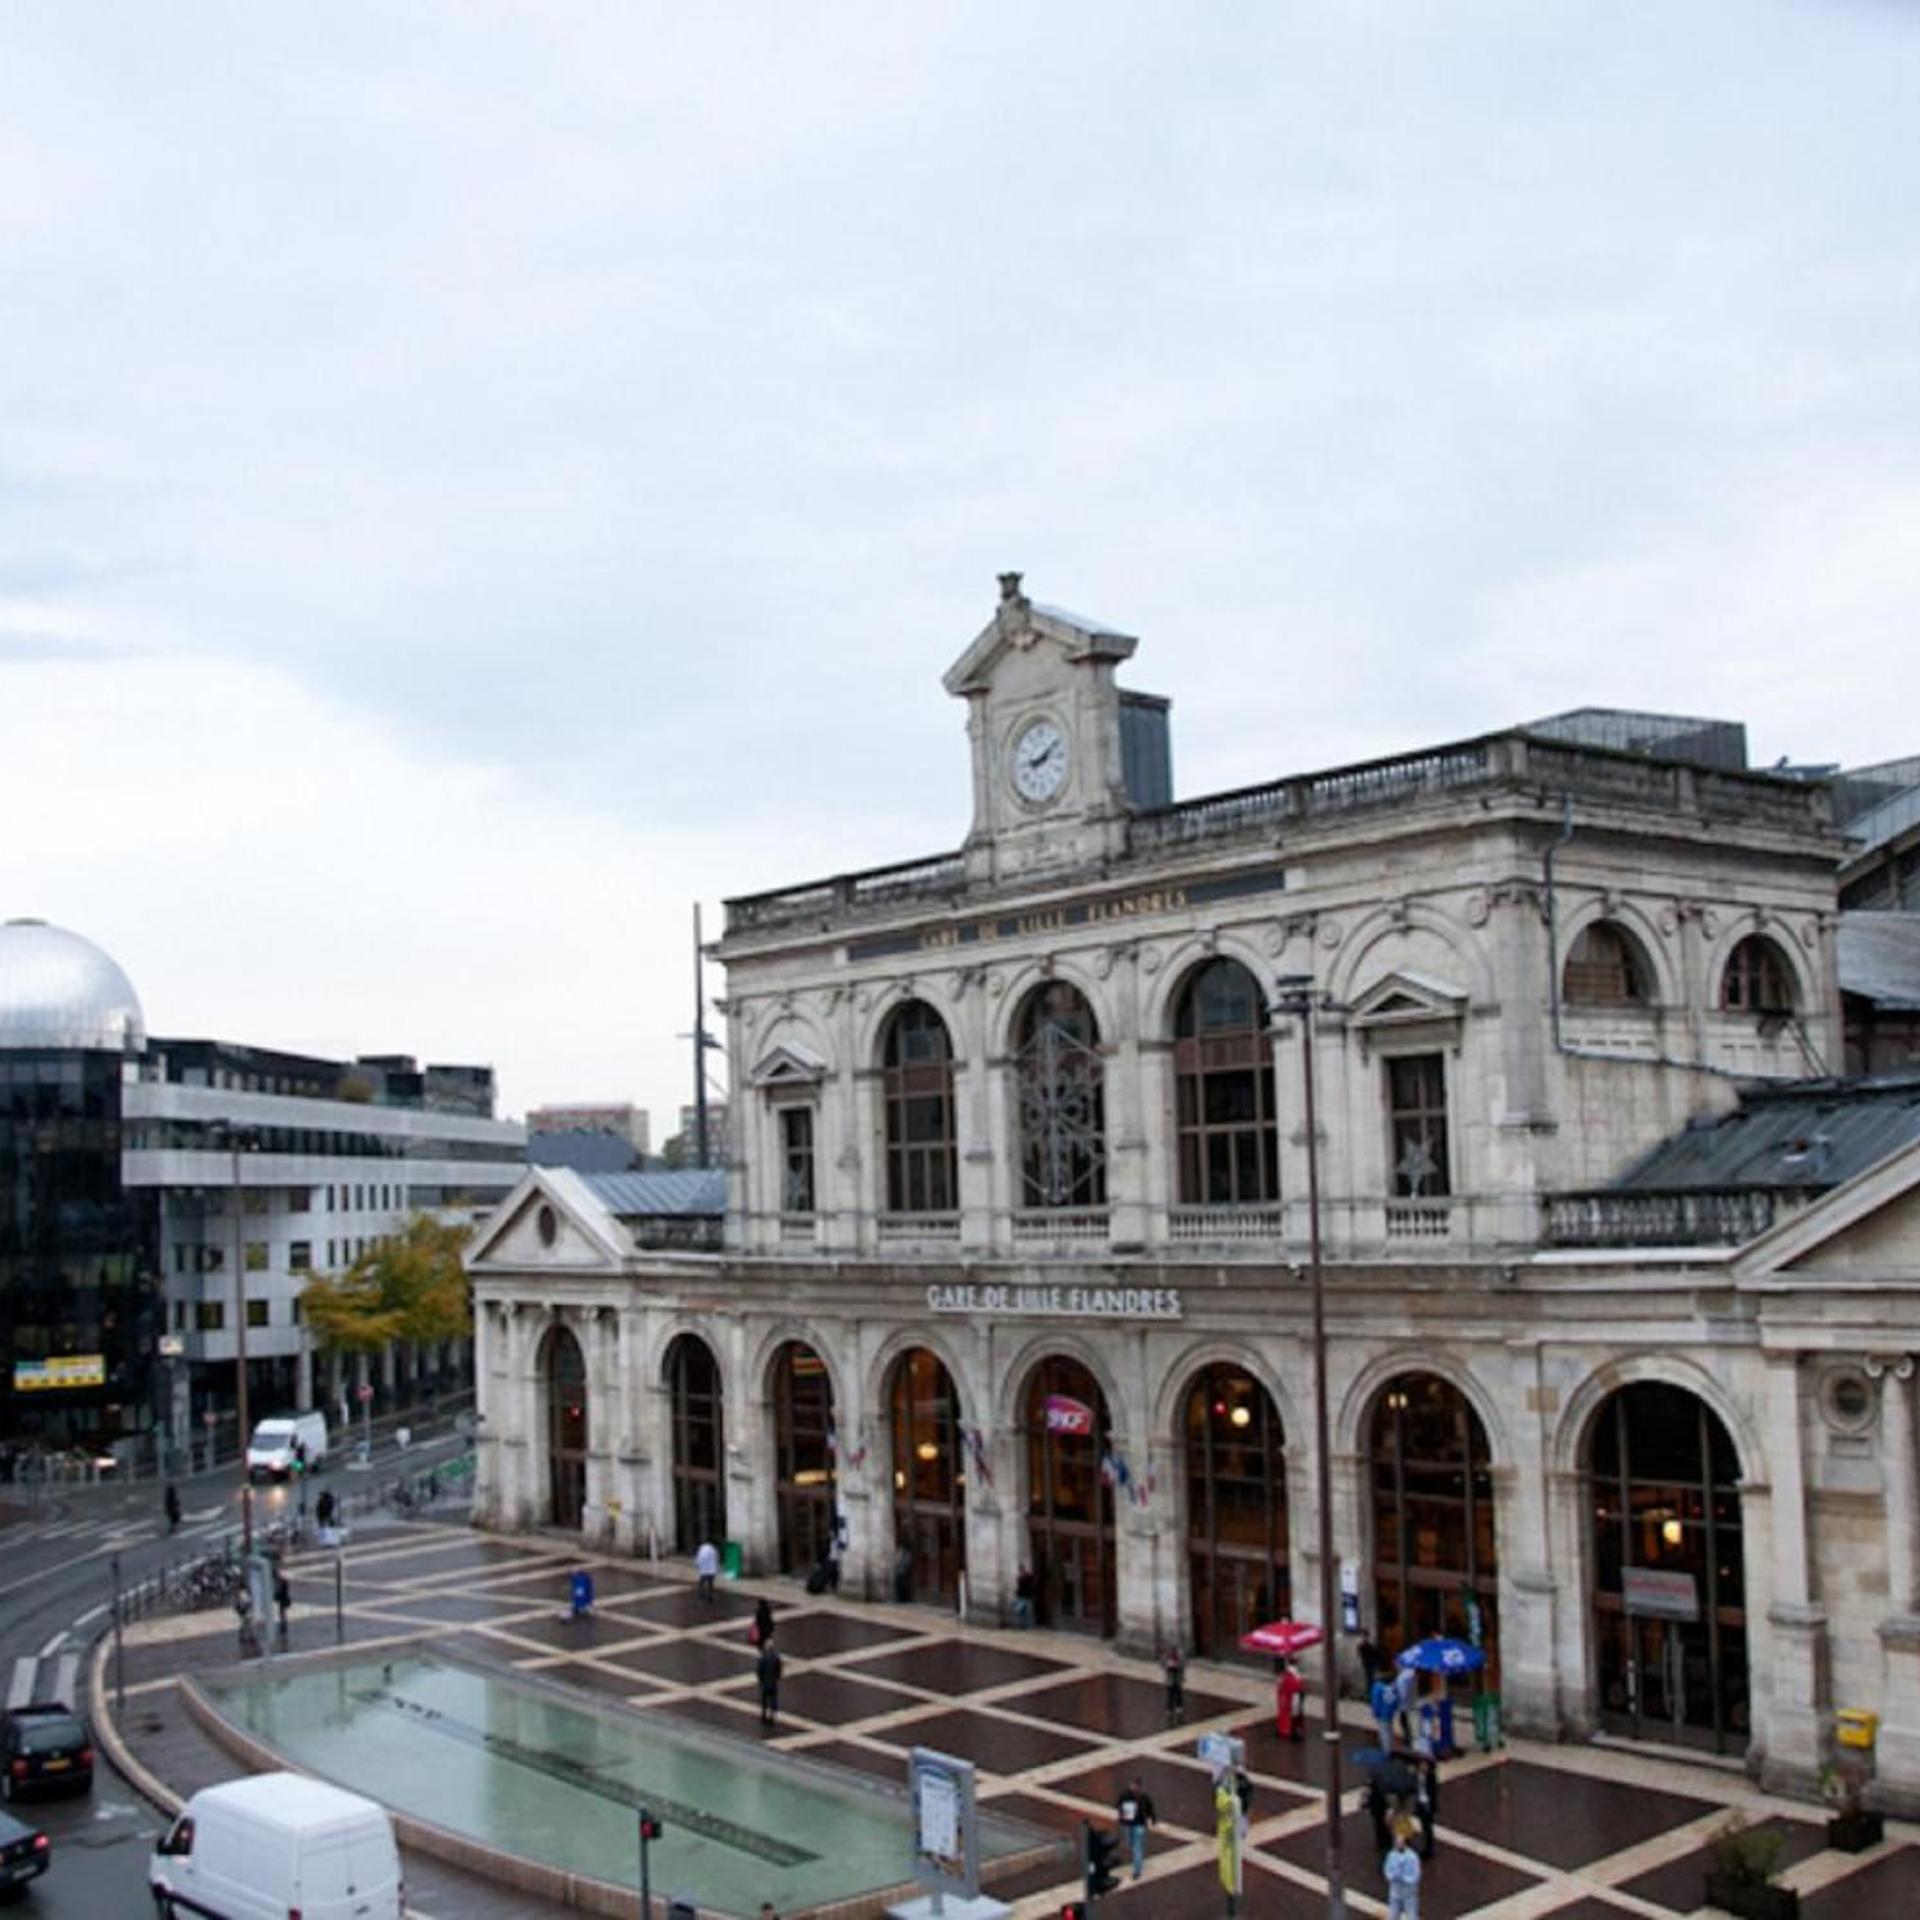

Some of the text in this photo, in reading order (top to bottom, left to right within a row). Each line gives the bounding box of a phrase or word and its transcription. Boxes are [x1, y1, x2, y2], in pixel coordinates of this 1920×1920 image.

[927, 1285, 976, 1309] GARE
[985, 1285, 1009, 1309] DE
[1071, 1288, 1181, 1313] FLANDRES
